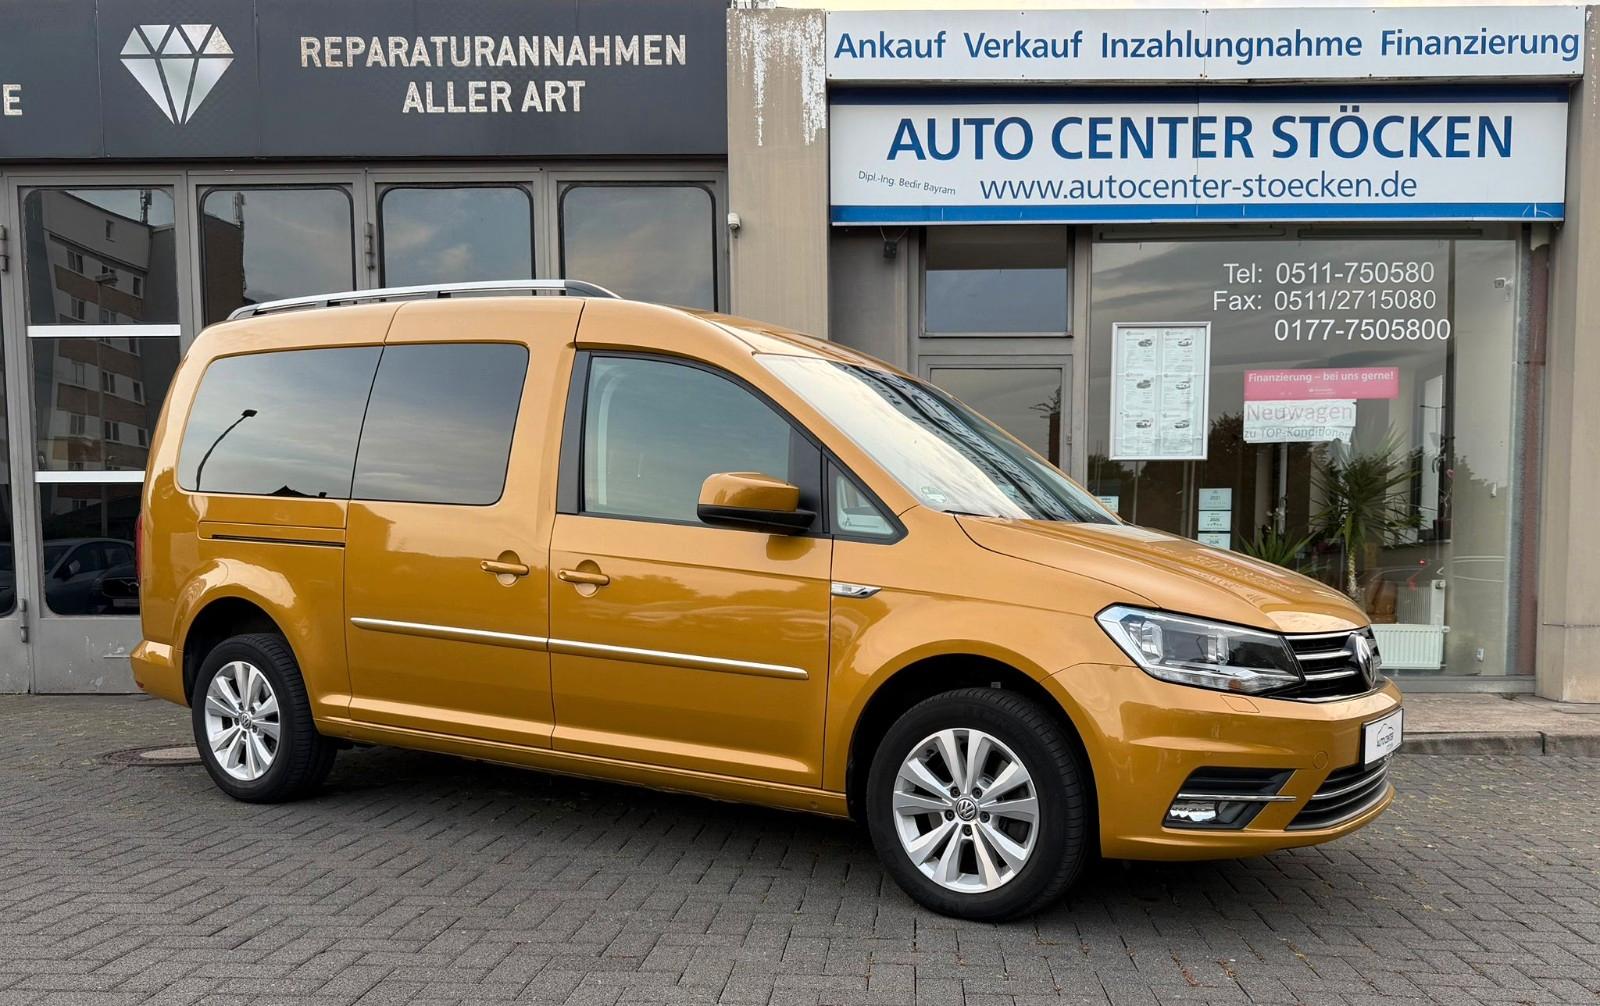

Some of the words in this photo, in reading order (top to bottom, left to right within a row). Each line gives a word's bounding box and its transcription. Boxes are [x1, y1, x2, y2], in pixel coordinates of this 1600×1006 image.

[300, 34, 686, 68] REPARATURANNAHMEN
[834, 31, 946, 59] Ankauf
[964, 30, 1083, 59] Verkauf
[1102, 29, 1362, 65] Inzahlungnahme
[1381, 28, 1580, 61] Finanzierung
[402, 80, 513, 114] ALLER
[521, 80, 586, 113] ART
[886, 117, 1034, 160] AUTO
[1051, 116, 1254, 160] CENTER
[1272, 105, 1513, 159] STÖCKEN
[899, 178, 921, 189] Bedir
[924, 182, 957, 195] Bayram
[980, 171, 1417, 199] www.autocenter-stoecken.de
[1223, 263, 1263, 284] Tel:
[1276, 261, 1435, 284] 0511-750580
[1213, 290, 1262, 311] Fax:
[1274, 289, 1436, 311] 0511/2715080
[1274, 318, 1451, 341] 0177-7505800
[1248, 372, 1312, 383] Finanzierung
[1323, 371, 1338, 381] bei
[1341, 373, 1359, 381] uns
[1361, 371, 1394, 383] gerne!
[1247, 404, 1352, 424] Neuwagen
